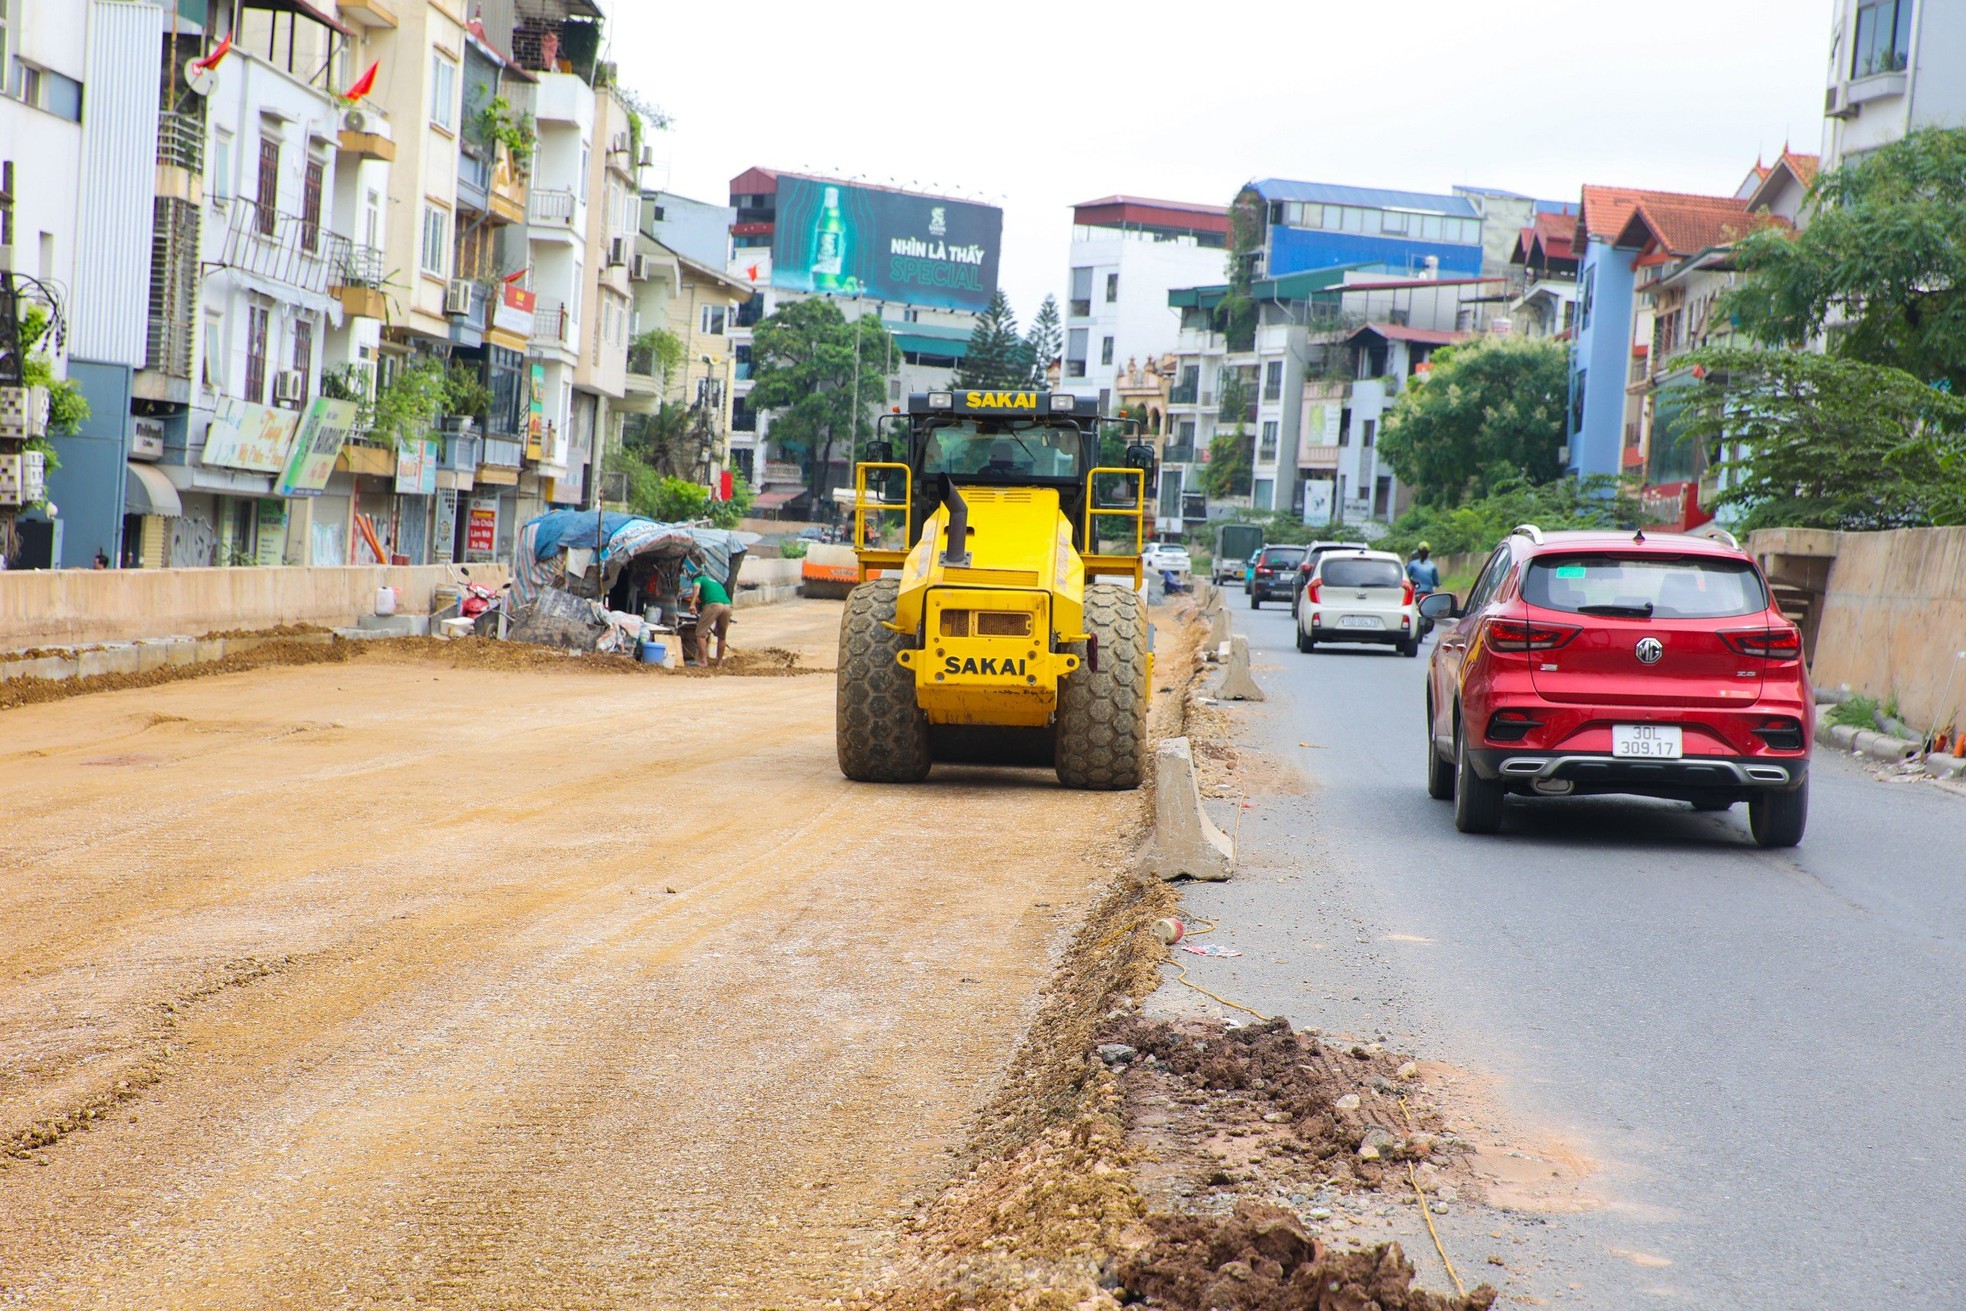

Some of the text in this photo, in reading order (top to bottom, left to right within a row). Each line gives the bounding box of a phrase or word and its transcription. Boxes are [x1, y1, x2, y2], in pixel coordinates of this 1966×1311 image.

[890, 236, 985, 265] NHÌN LÀ THẤY
[889, 256, 984, 292] SPECIAL
[966, 391, 1037, 409] SAKAI
[1637, 638, 1662, 662] MG
[944, 656, 1026, 676] SAKAI
[1632, 726, 1661, 740] 30L
[1621, 741, 1673, 755] 309.17
